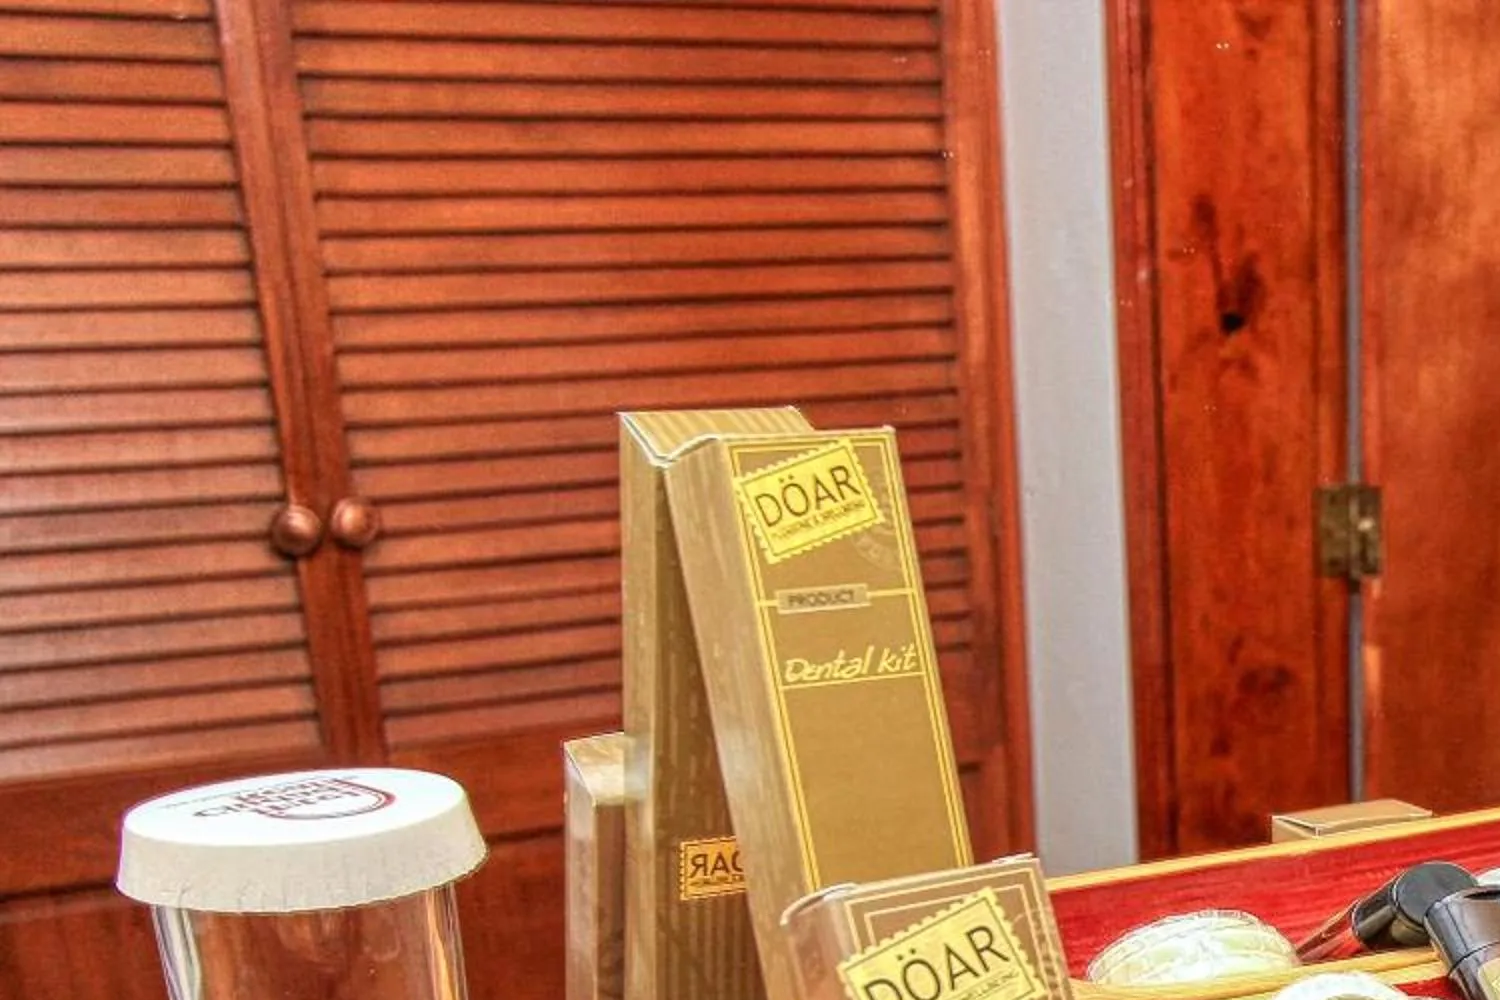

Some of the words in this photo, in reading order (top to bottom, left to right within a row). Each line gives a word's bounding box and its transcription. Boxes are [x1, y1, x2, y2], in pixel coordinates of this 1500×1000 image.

[755, 465, 861, 528] DÖAR
[788, 589, 855, 608] PRODUCT
[784, 645, 874, 683] Dental
[878, 643, 918, 674] kit
